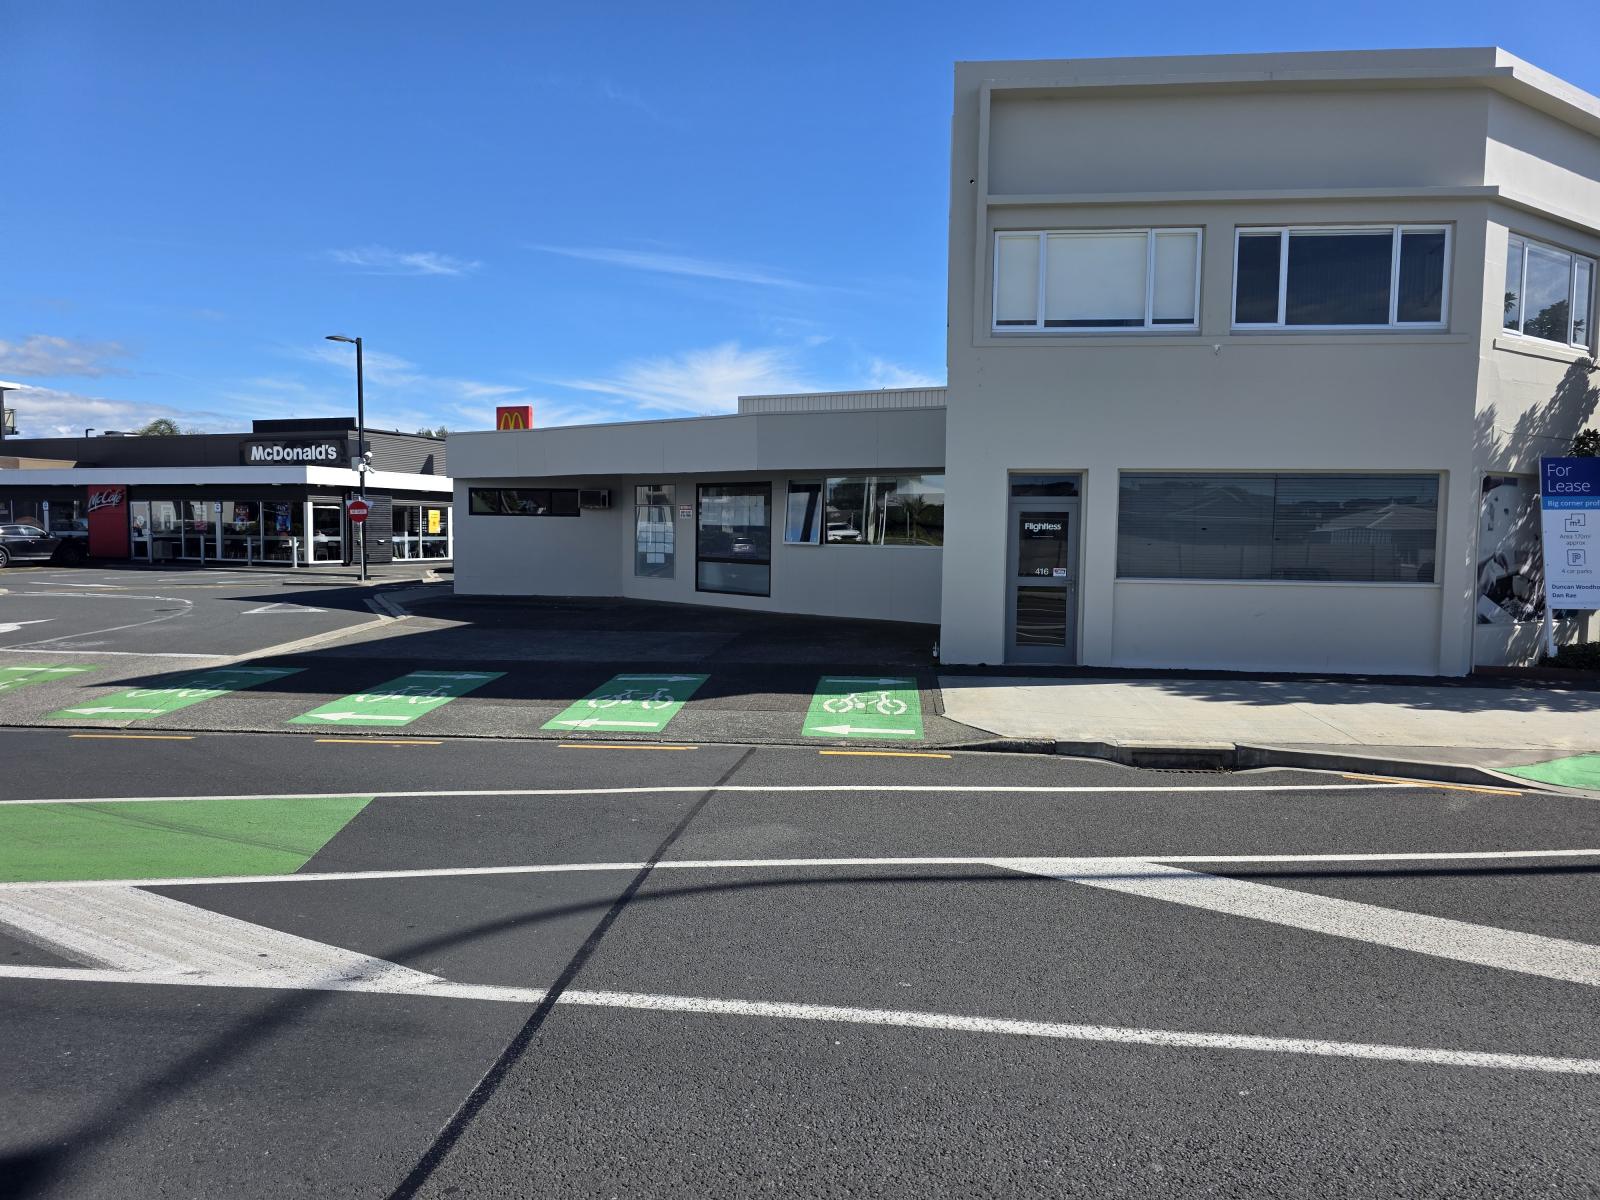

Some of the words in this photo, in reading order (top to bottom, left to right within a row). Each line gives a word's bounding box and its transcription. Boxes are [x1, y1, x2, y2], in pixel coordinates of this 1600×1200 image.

[250, 444, 338, 461] McDonald's
[1547, 463, 1572, 477] For
[1548, 479, 1591, 493] Lease
[1547, 500, 1559, 508] Big
[1025, 522, 1062, 532] Flightless
